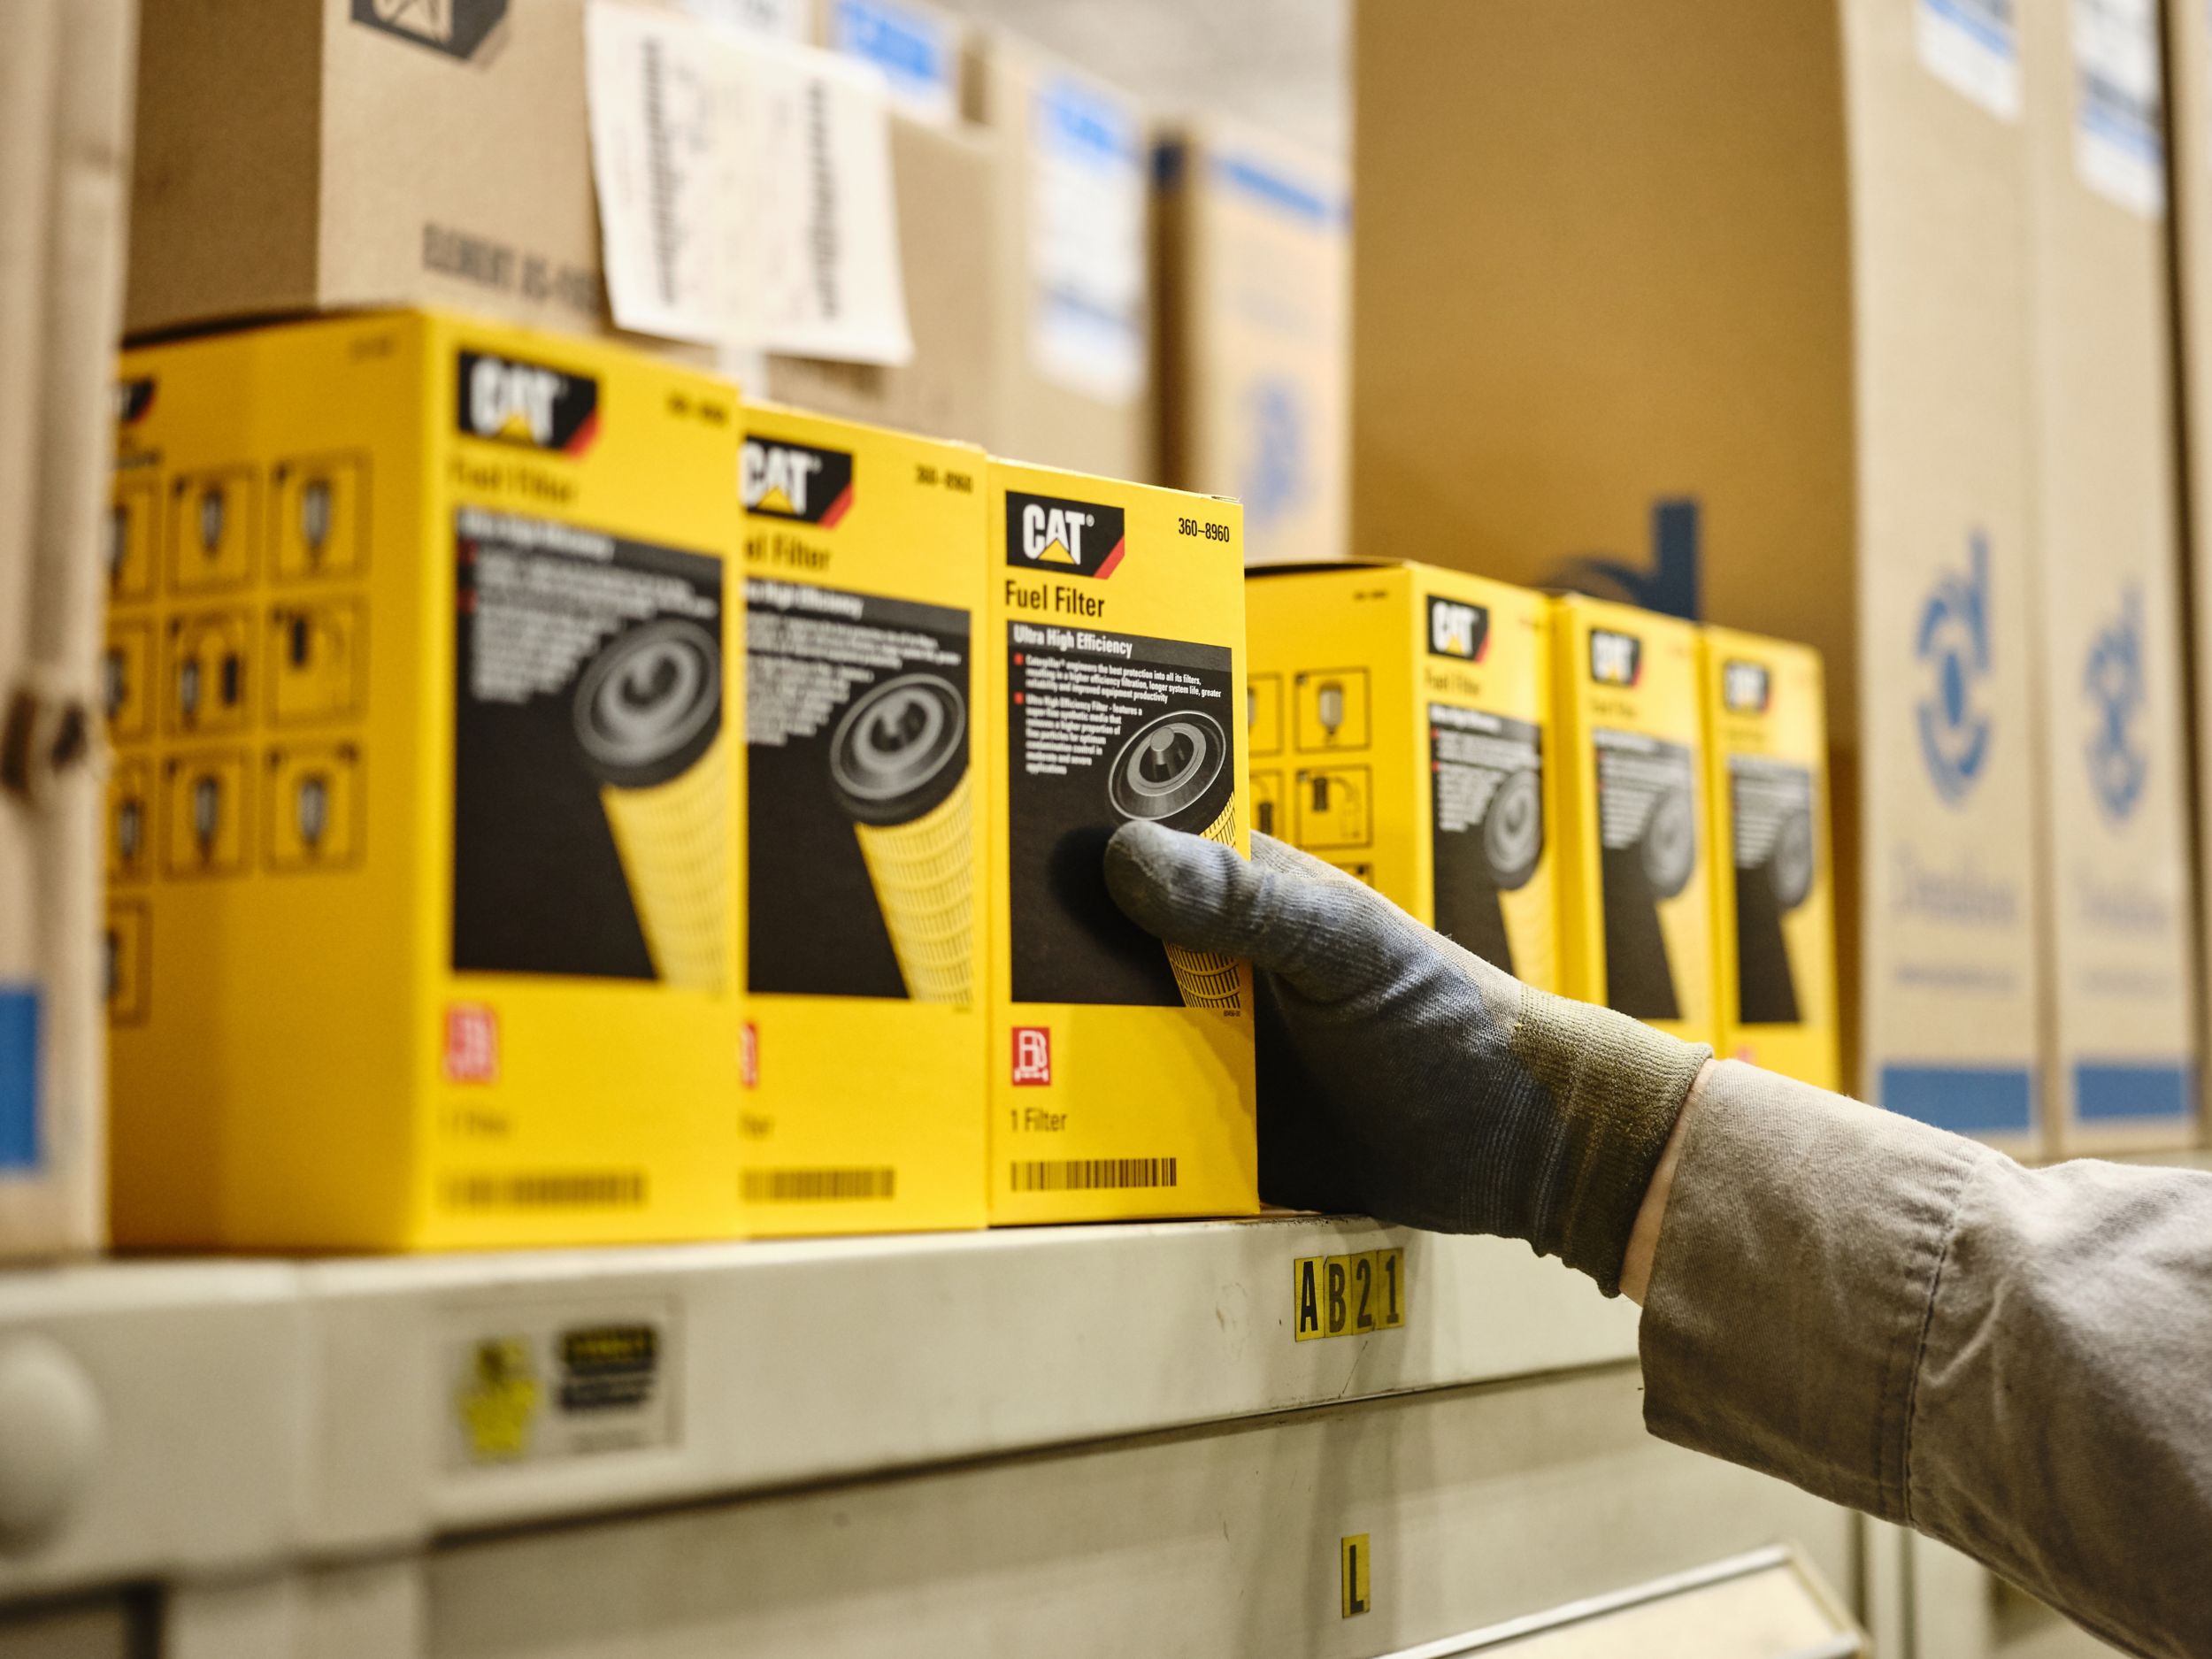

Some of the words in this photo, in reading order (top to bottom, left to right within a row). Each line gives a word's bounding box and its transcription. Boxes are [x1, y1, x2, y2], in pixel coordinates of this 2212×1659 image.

[1178, 517, 1230, 543] 360-8960
[1005, 580, 1048, 610] Fuel
[1055, 585, 1105, 618] Filter
[1013, 623, 1045, 644] Ultra
[1046, 627, 1075, 651] High
[1077, 631, 1133, 659] Efficiency
[1090, 673, 1120, 688] efficiency
[1148, 680, 1168, 693] longer
[1169, 685, 1189, 695] system
[1189, 686, 1200, 696] life,
[1110, 664, 1123, 676] best
[1123, 668, 1154, 680] protection
[1154, 671, 1165, 681] into
[1183, 674, 1202, 686] filters,
[1112, 703, 1138, 716] features
[1138, 708, 1143, 717] a
[1133, 690, 1168, 704] productivity
[1024, 1107, 1067, 1133] Filter
[1300, 1255, 1400, 1333] AB21
[1349, 1544, 1364, 1615] L
